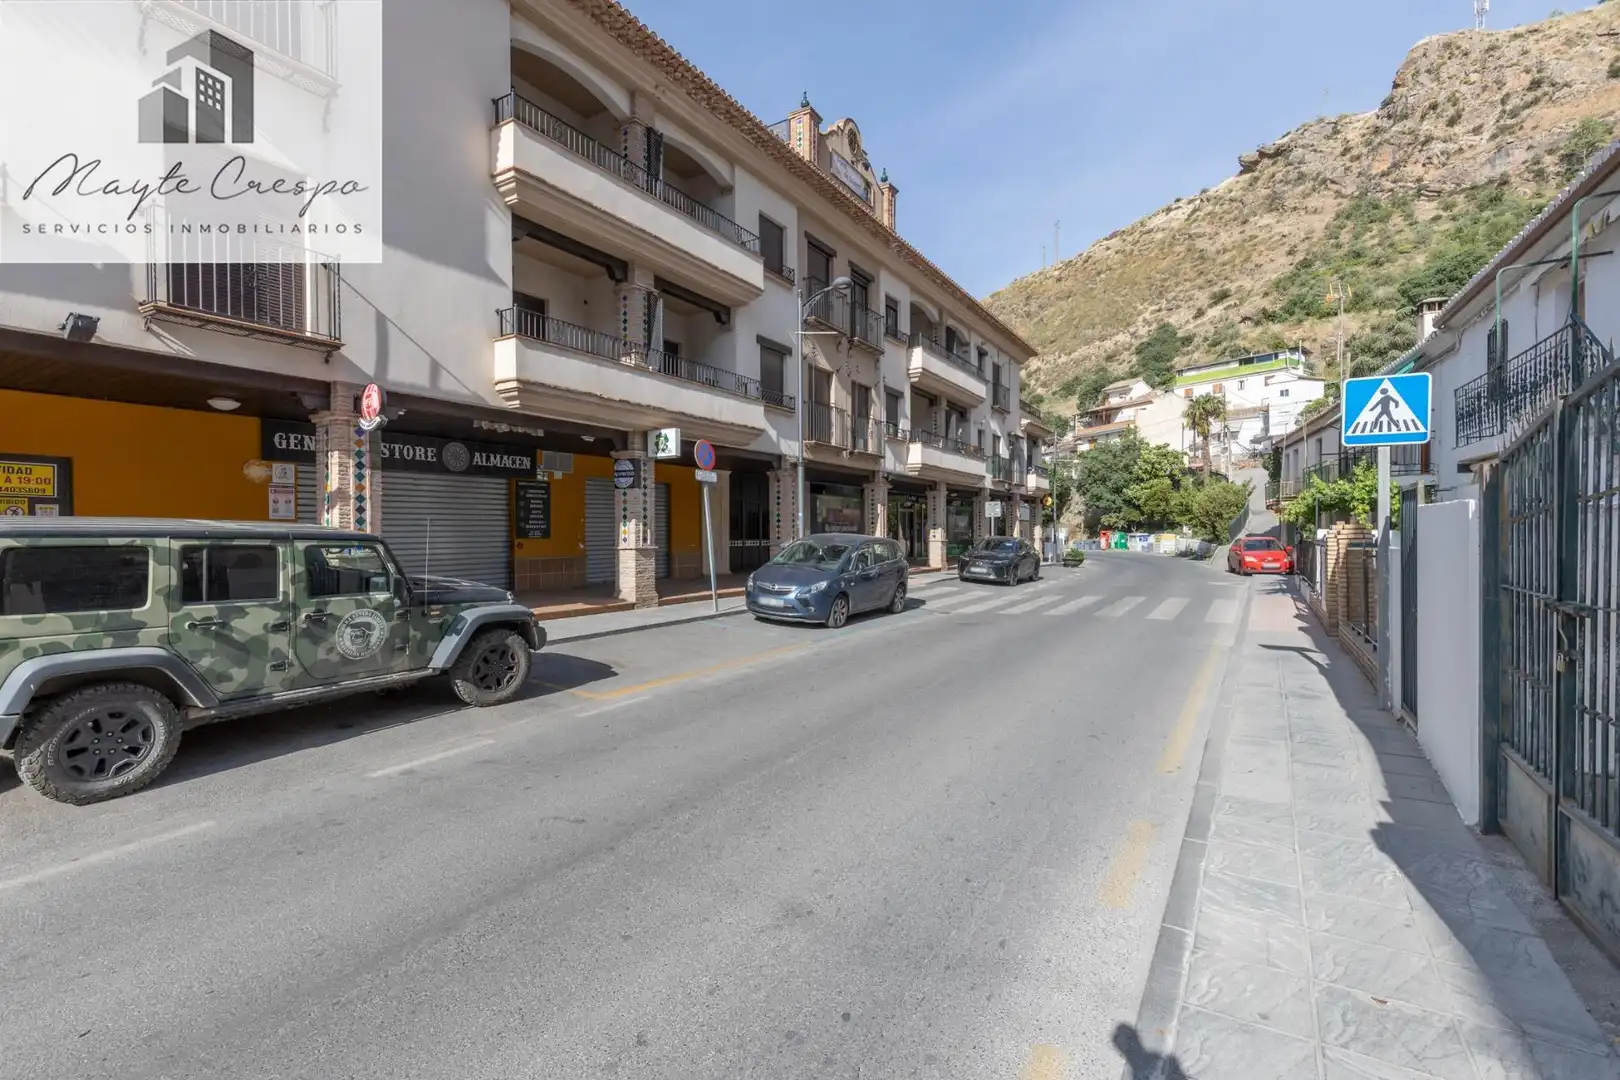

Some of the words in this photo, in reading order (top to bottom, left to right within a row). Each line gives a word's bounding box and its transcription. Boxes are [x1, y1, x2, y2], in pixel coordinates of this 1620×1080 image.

[381, 442, 437, 462] STORE
[472, 452, 531, 469] ALMACEN
[0, 465, 32, 475] IDAD
